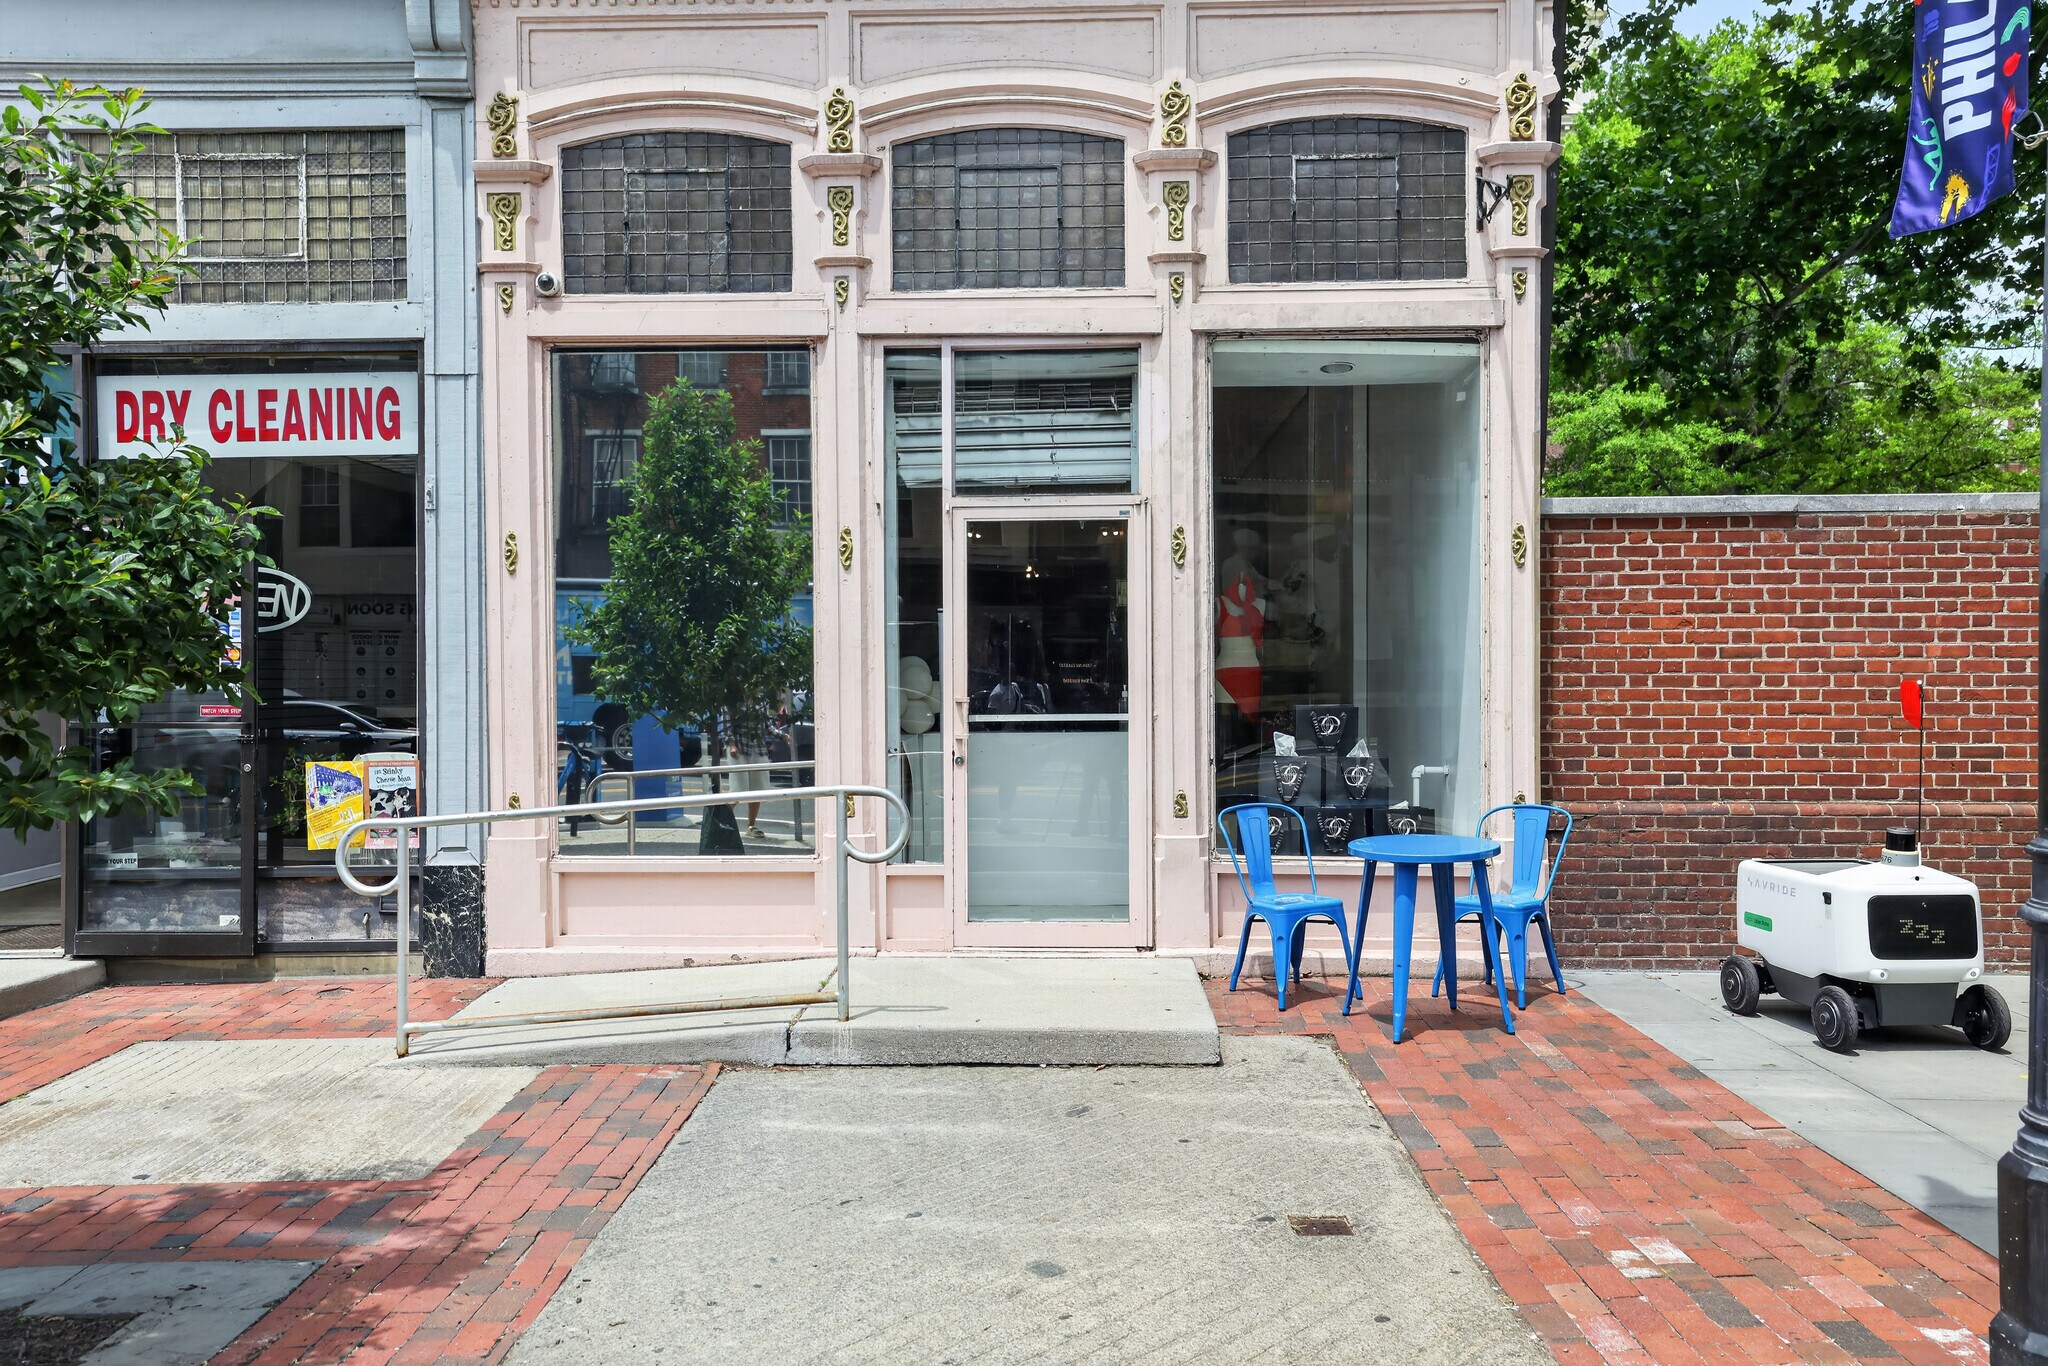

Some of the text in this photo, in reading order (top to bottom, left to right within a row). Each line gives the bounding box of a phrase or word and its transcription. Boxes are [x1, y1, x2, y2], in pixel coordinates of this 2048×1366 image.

[1942, 0, 1997, 141] PHIL
[115, 385, 401, 444] DRY CLEANING
[1754, 879, 1797, 898] AVRIDE
